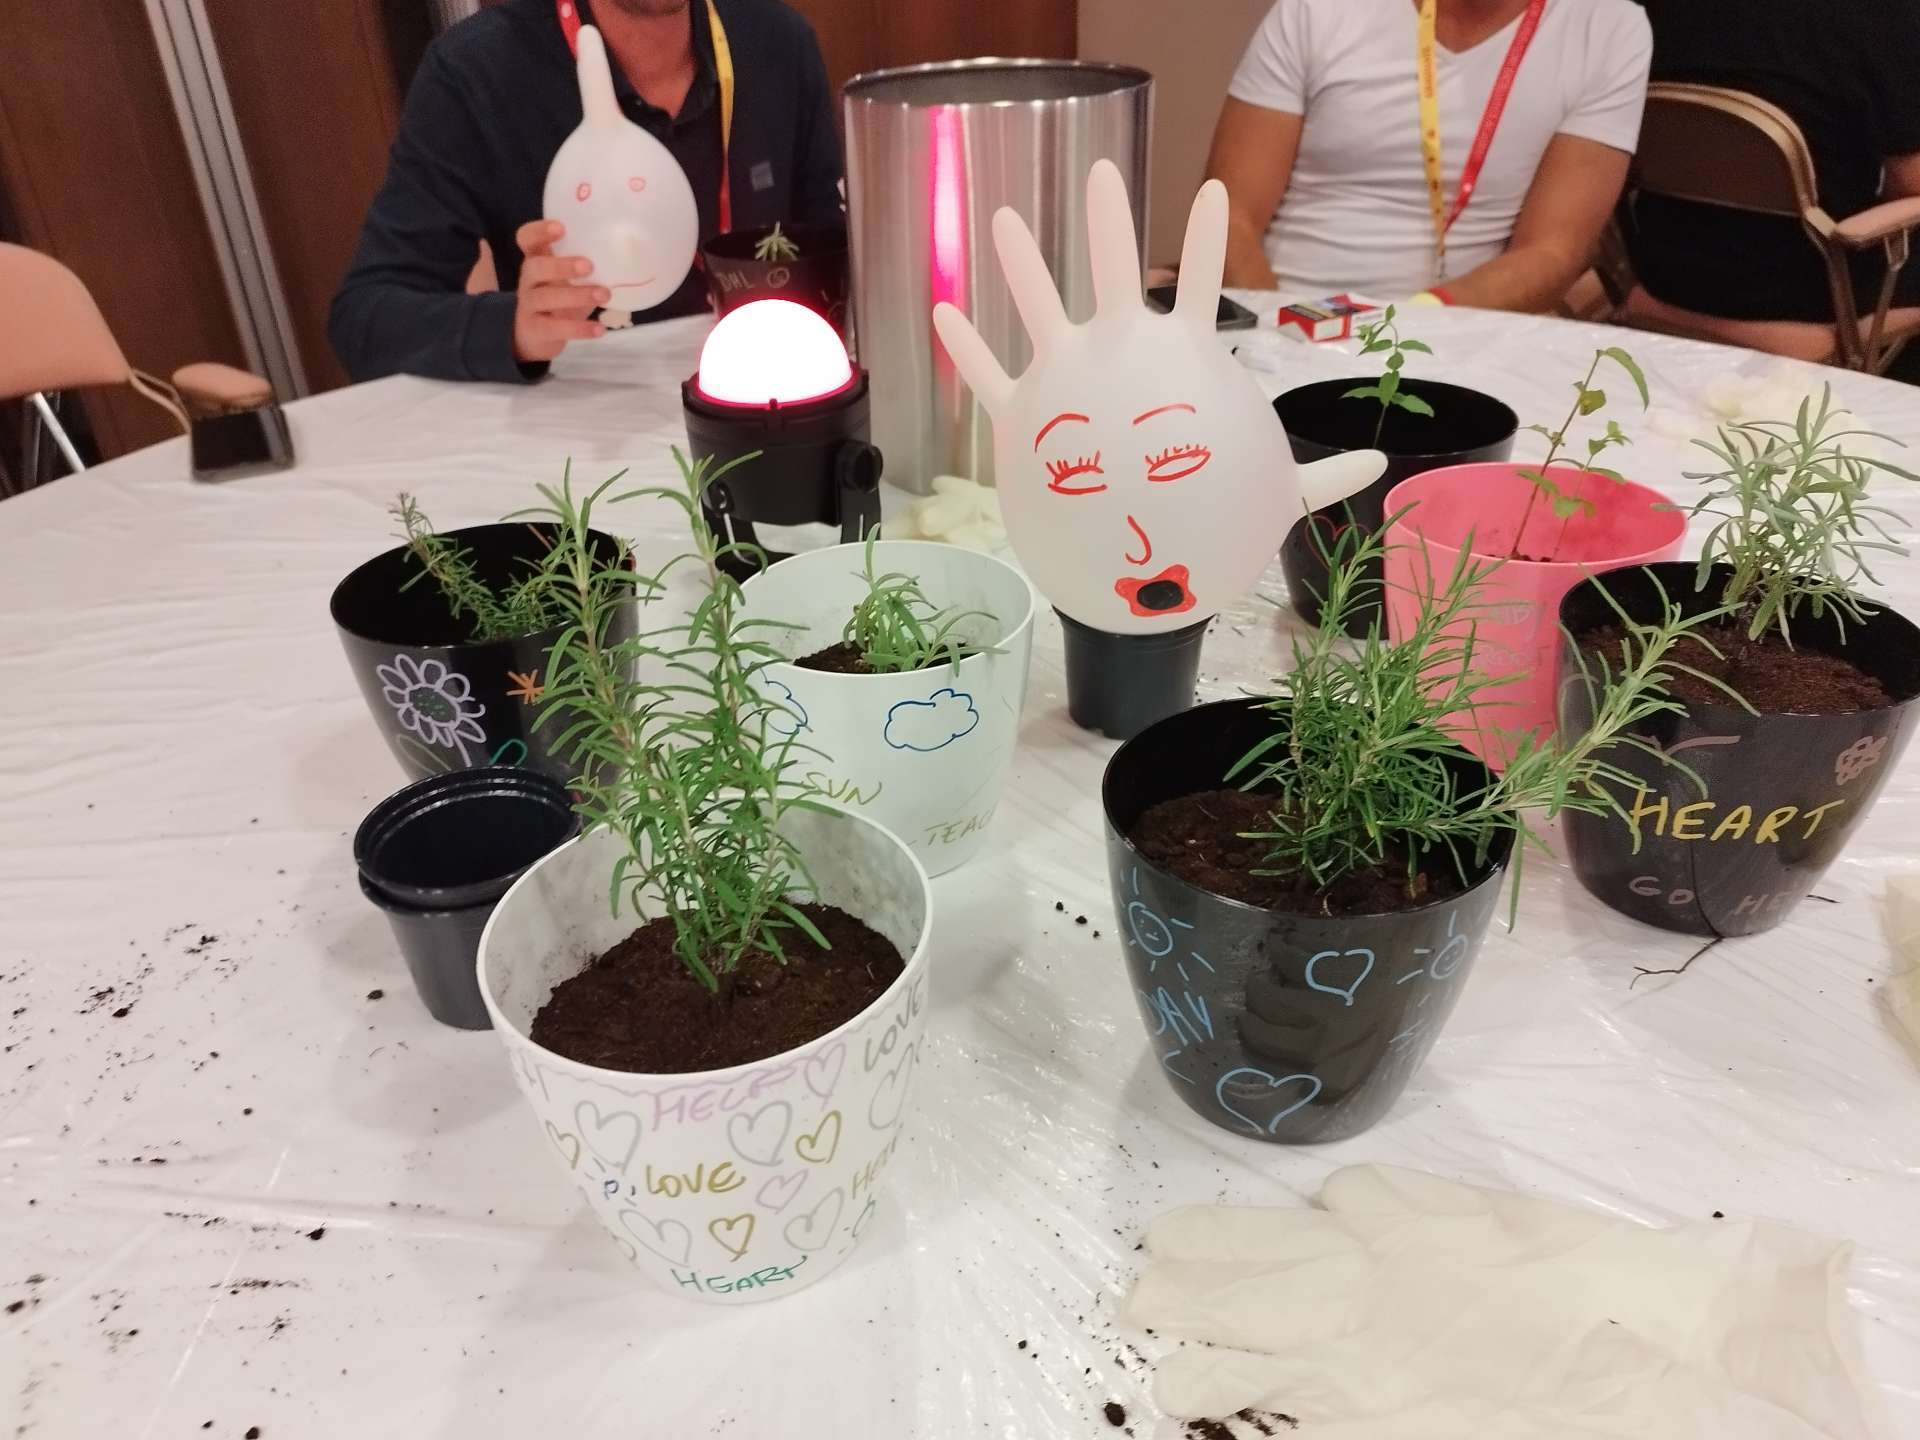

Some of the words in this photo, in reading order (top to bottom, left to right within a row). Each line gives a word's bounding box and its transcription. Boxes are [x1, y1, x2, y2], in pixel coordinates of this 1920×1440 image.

[805, 772, 882, 805] SUN
[1629, 784, 1845, 844] HEART
[864, 973, 923, 1072] LOVE
[652, 1066, 797, 1132] HELP
[646, 1161, 746, 1197] LOVE
[671, 1256, 807, 1293] HEART
